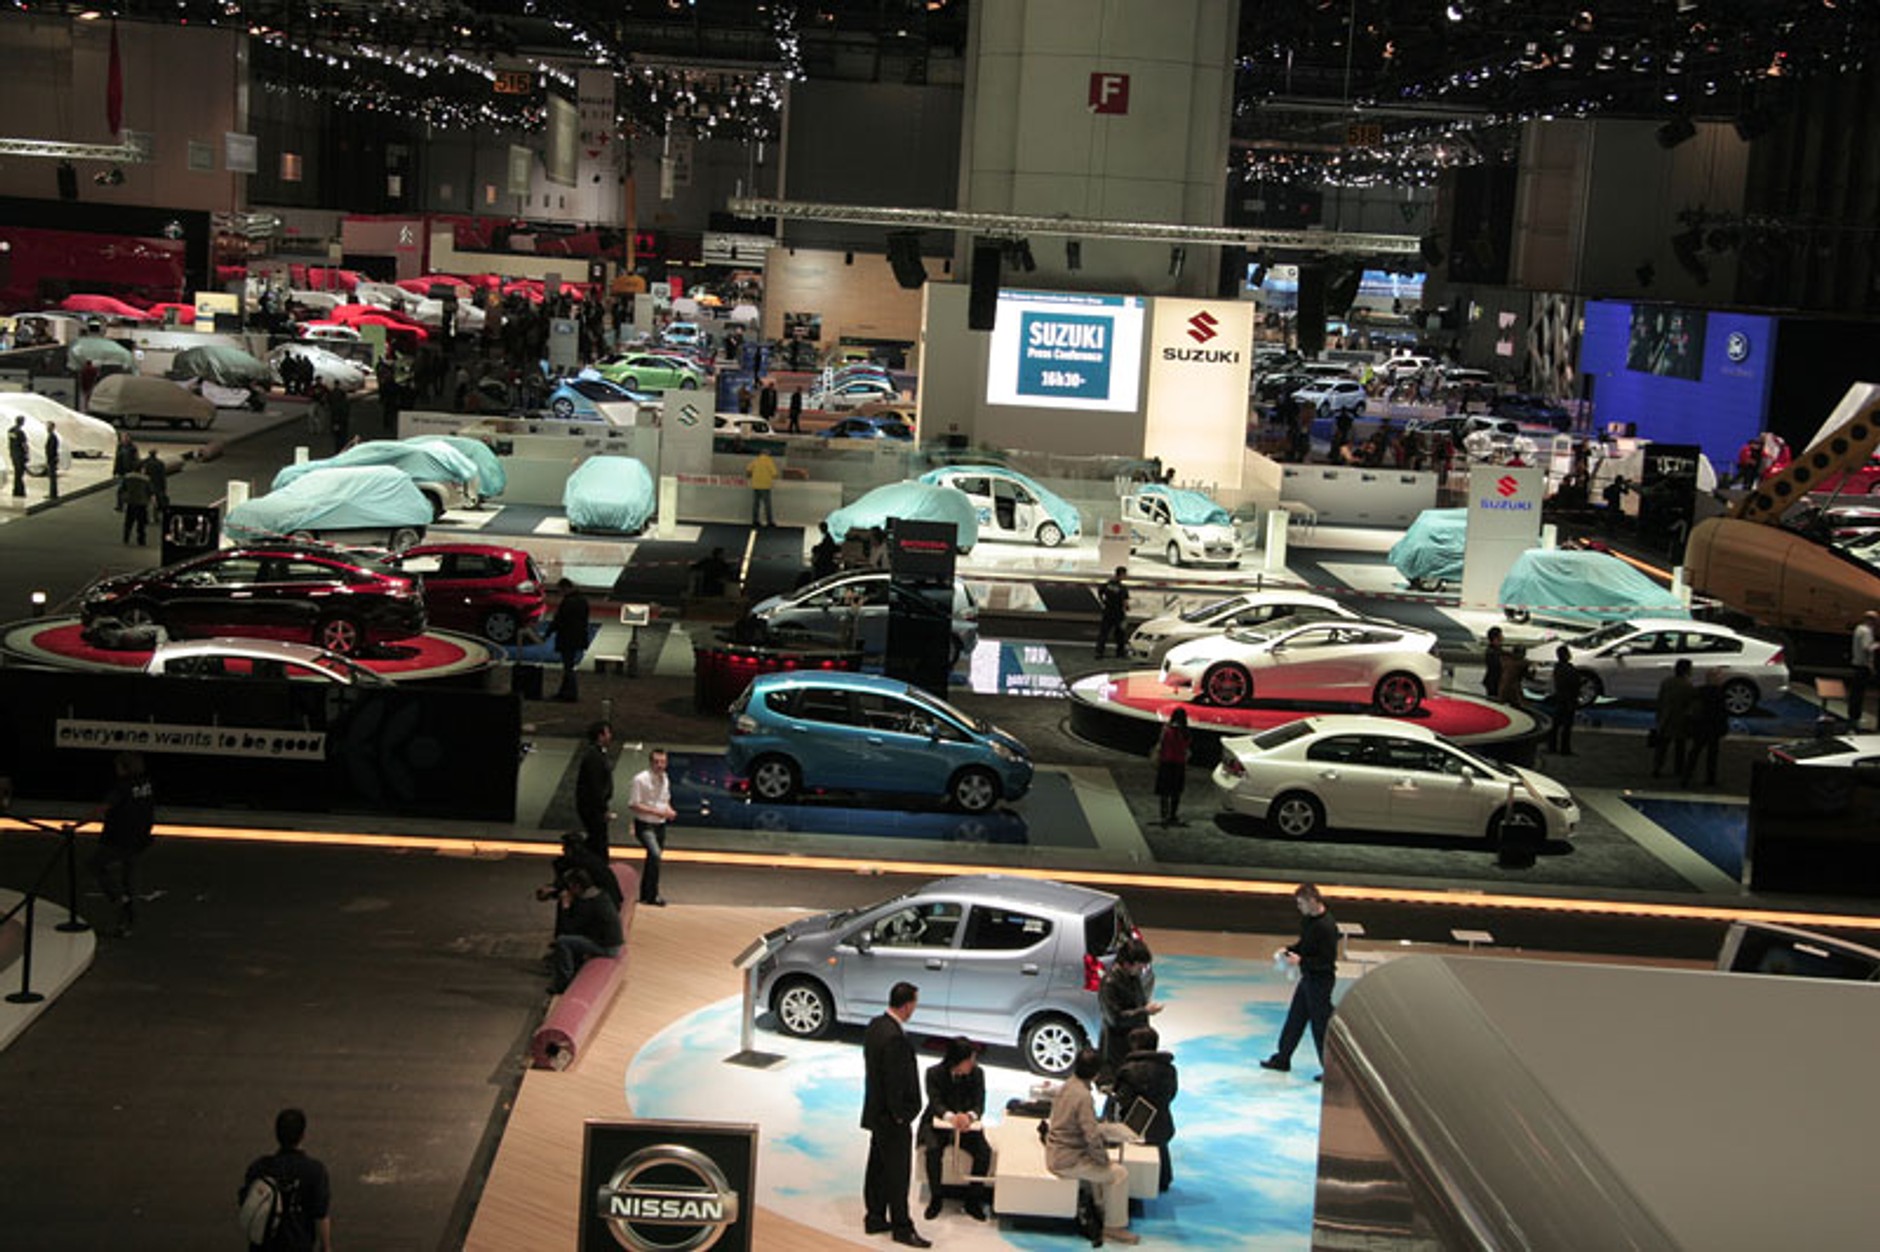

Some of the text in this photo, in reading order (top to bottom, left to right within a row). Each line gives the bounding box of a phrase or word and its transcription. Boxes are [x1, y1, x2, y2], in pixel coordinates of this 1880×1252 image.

[1101, 76, 1122, 104] F
[1028, 321, 1105, 349] SUZUKI
[1163, 347, 1240, 363] SUZUKI
[1480, 498, 1533, 511] SUZUKI
[60, 724, 322, 754] everyone wants to be good
[610, 1195, 723, 1219] NISSAN
